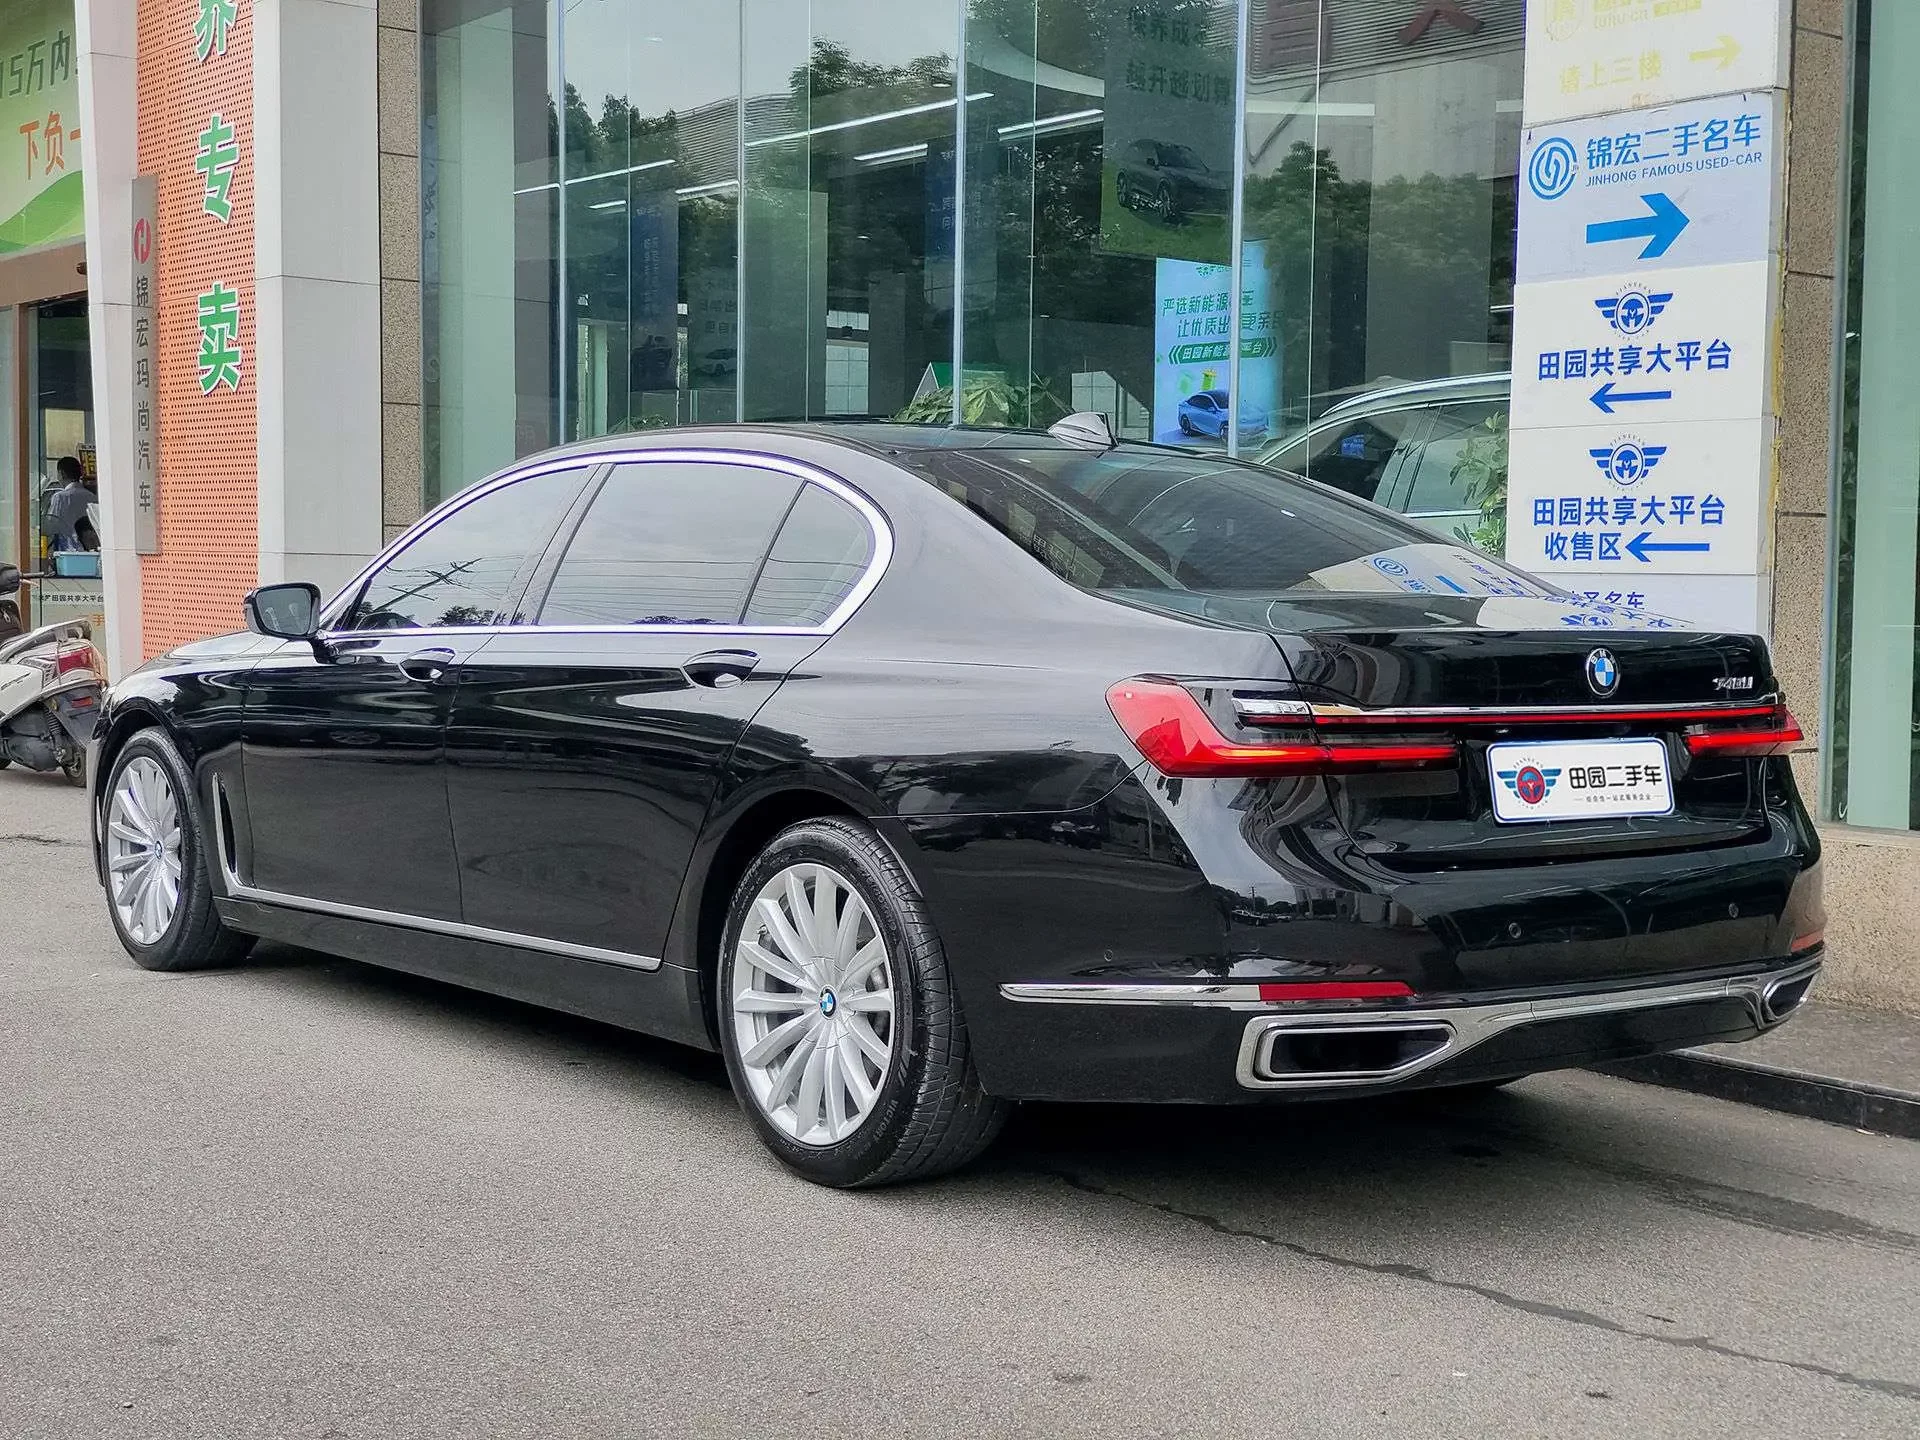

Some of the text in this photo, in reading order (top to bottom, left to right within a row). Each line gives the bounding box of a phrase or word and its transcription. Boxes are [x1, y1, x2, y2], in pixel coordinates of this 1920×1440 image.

[0, 30, 78, 99] 15万内
[1586, 114, 1762, 170] 锦宏二手名车
[1585, 169, 1637, 187] JINHONG
[1641, 162, 1693, 179] FAMOUS
[1695, 152, 1763, 172] USED-CAR
[1537, 339, 1733, 381] 田园共享大平台
[136, 275, 152, 513] 锦宏玛尚汽车
[1533, 494, 1726, 527] 田园共享大平台
[1544, 532, 1622, 562] 收售区
[1568, 765, 1663, 789] 田园二手车
